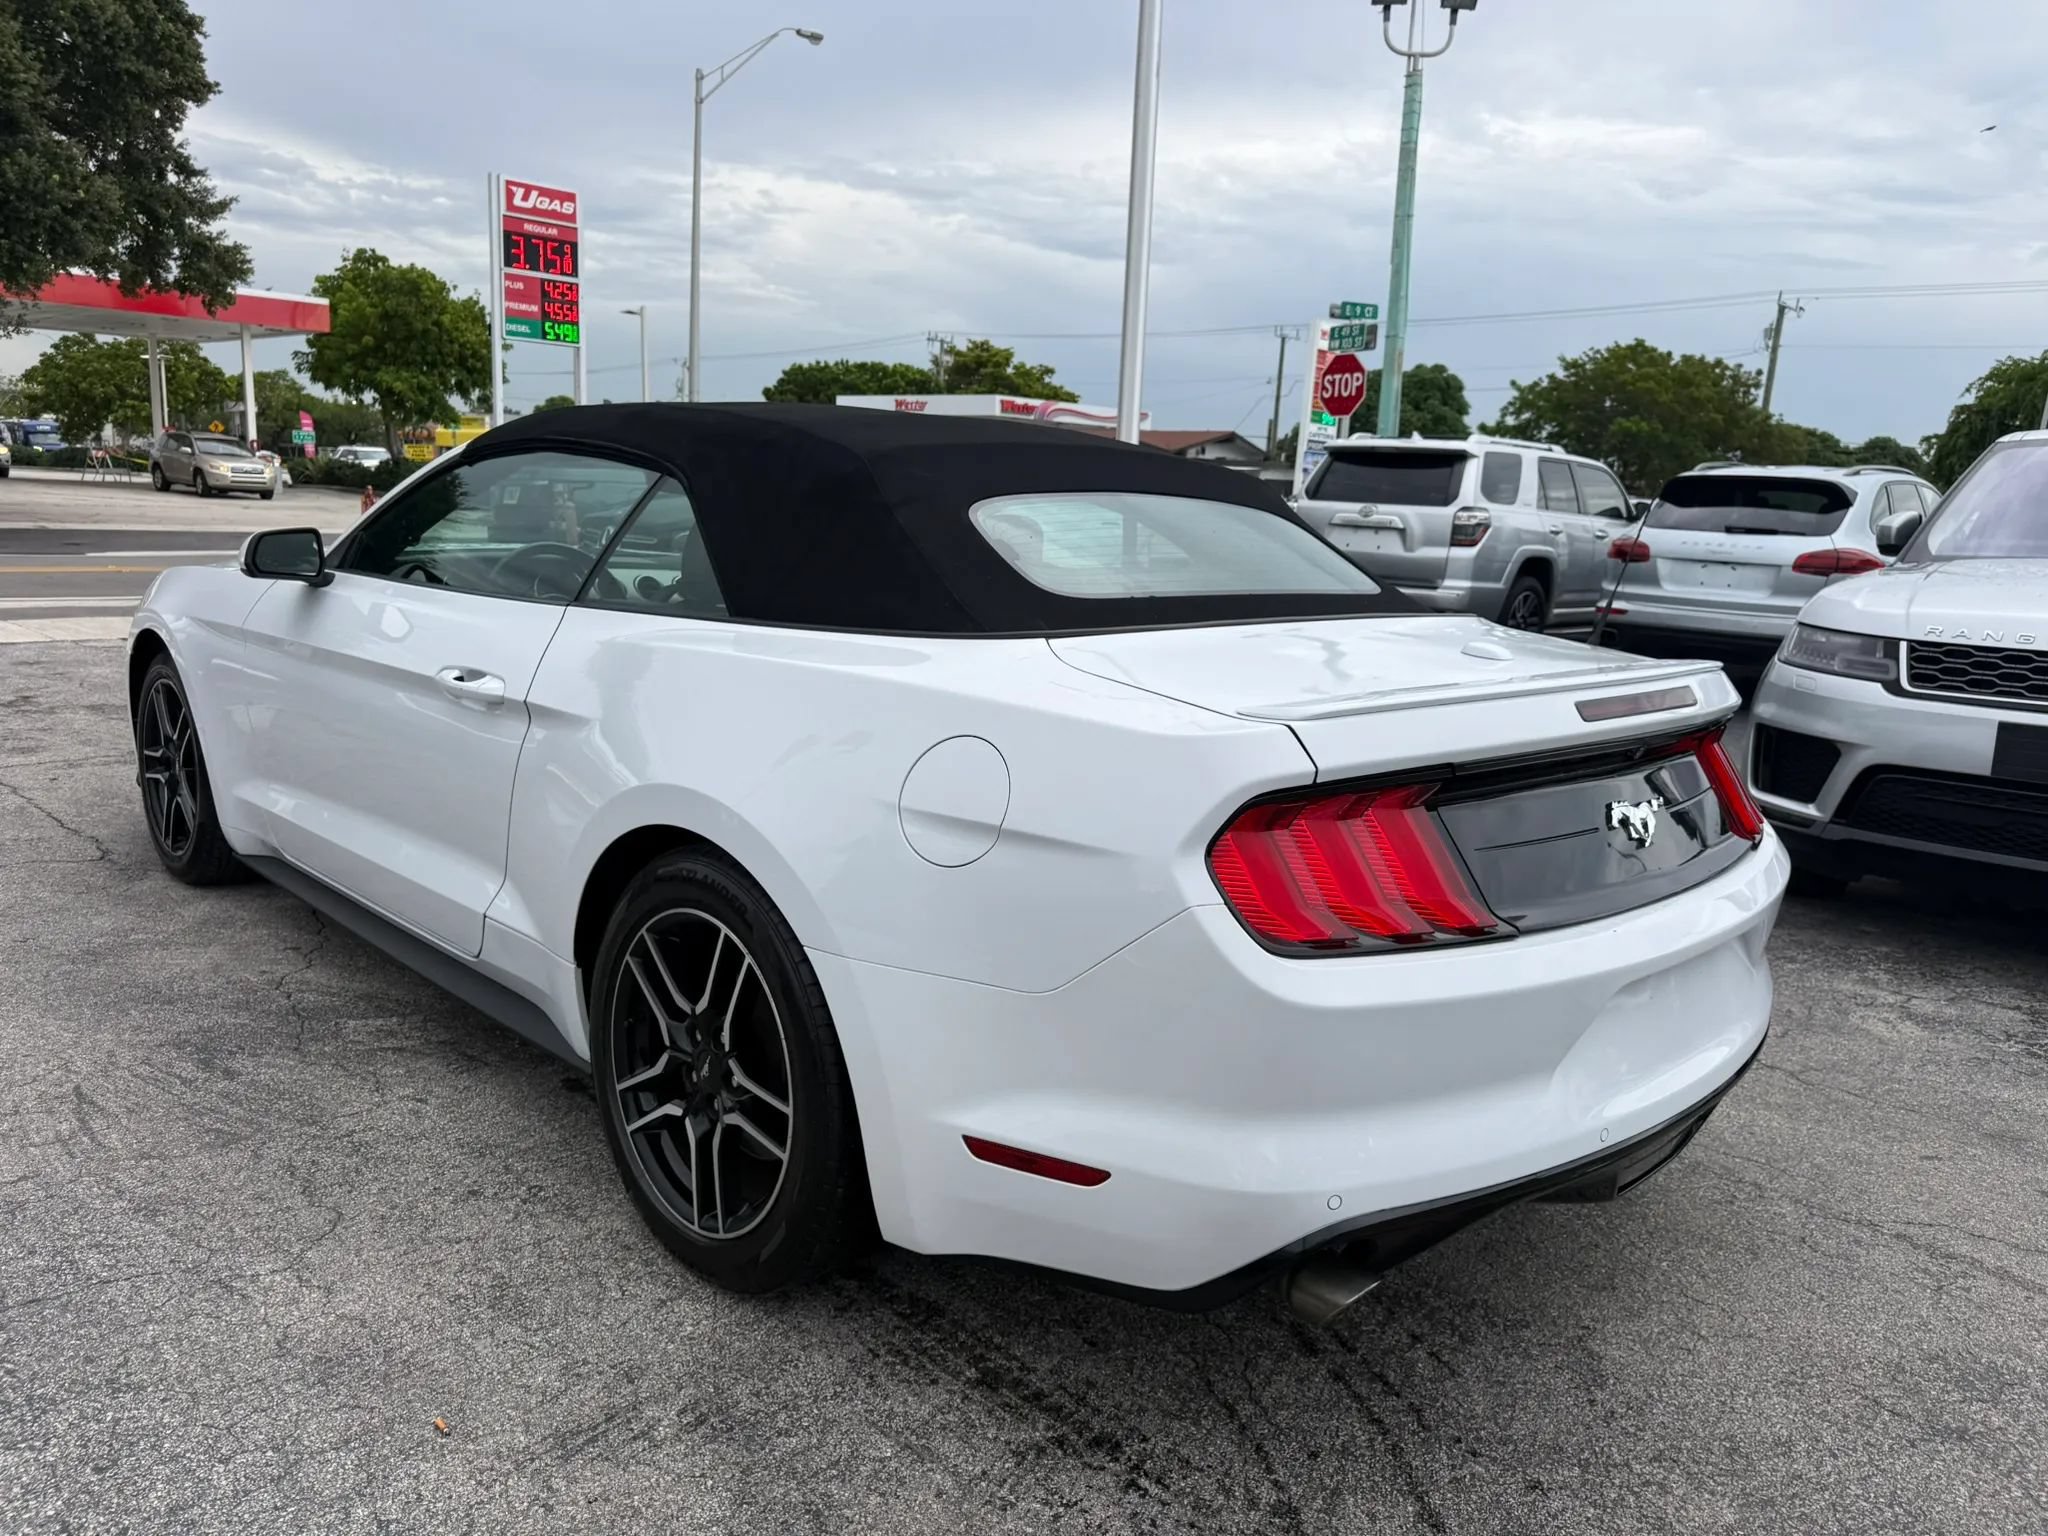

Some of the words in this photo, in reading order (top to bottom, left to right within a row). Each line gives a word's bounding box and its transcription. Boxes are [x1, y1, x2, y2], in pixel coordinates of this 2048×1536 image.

[523, 223, 558, 235] REGULAR
[505, 280, 525, 290] PLUS
[505, 301, 539, 313] PREMIUM
[506, 323, 531, 333] DIESEL
[1322, 372, 1363, 398] STOP
